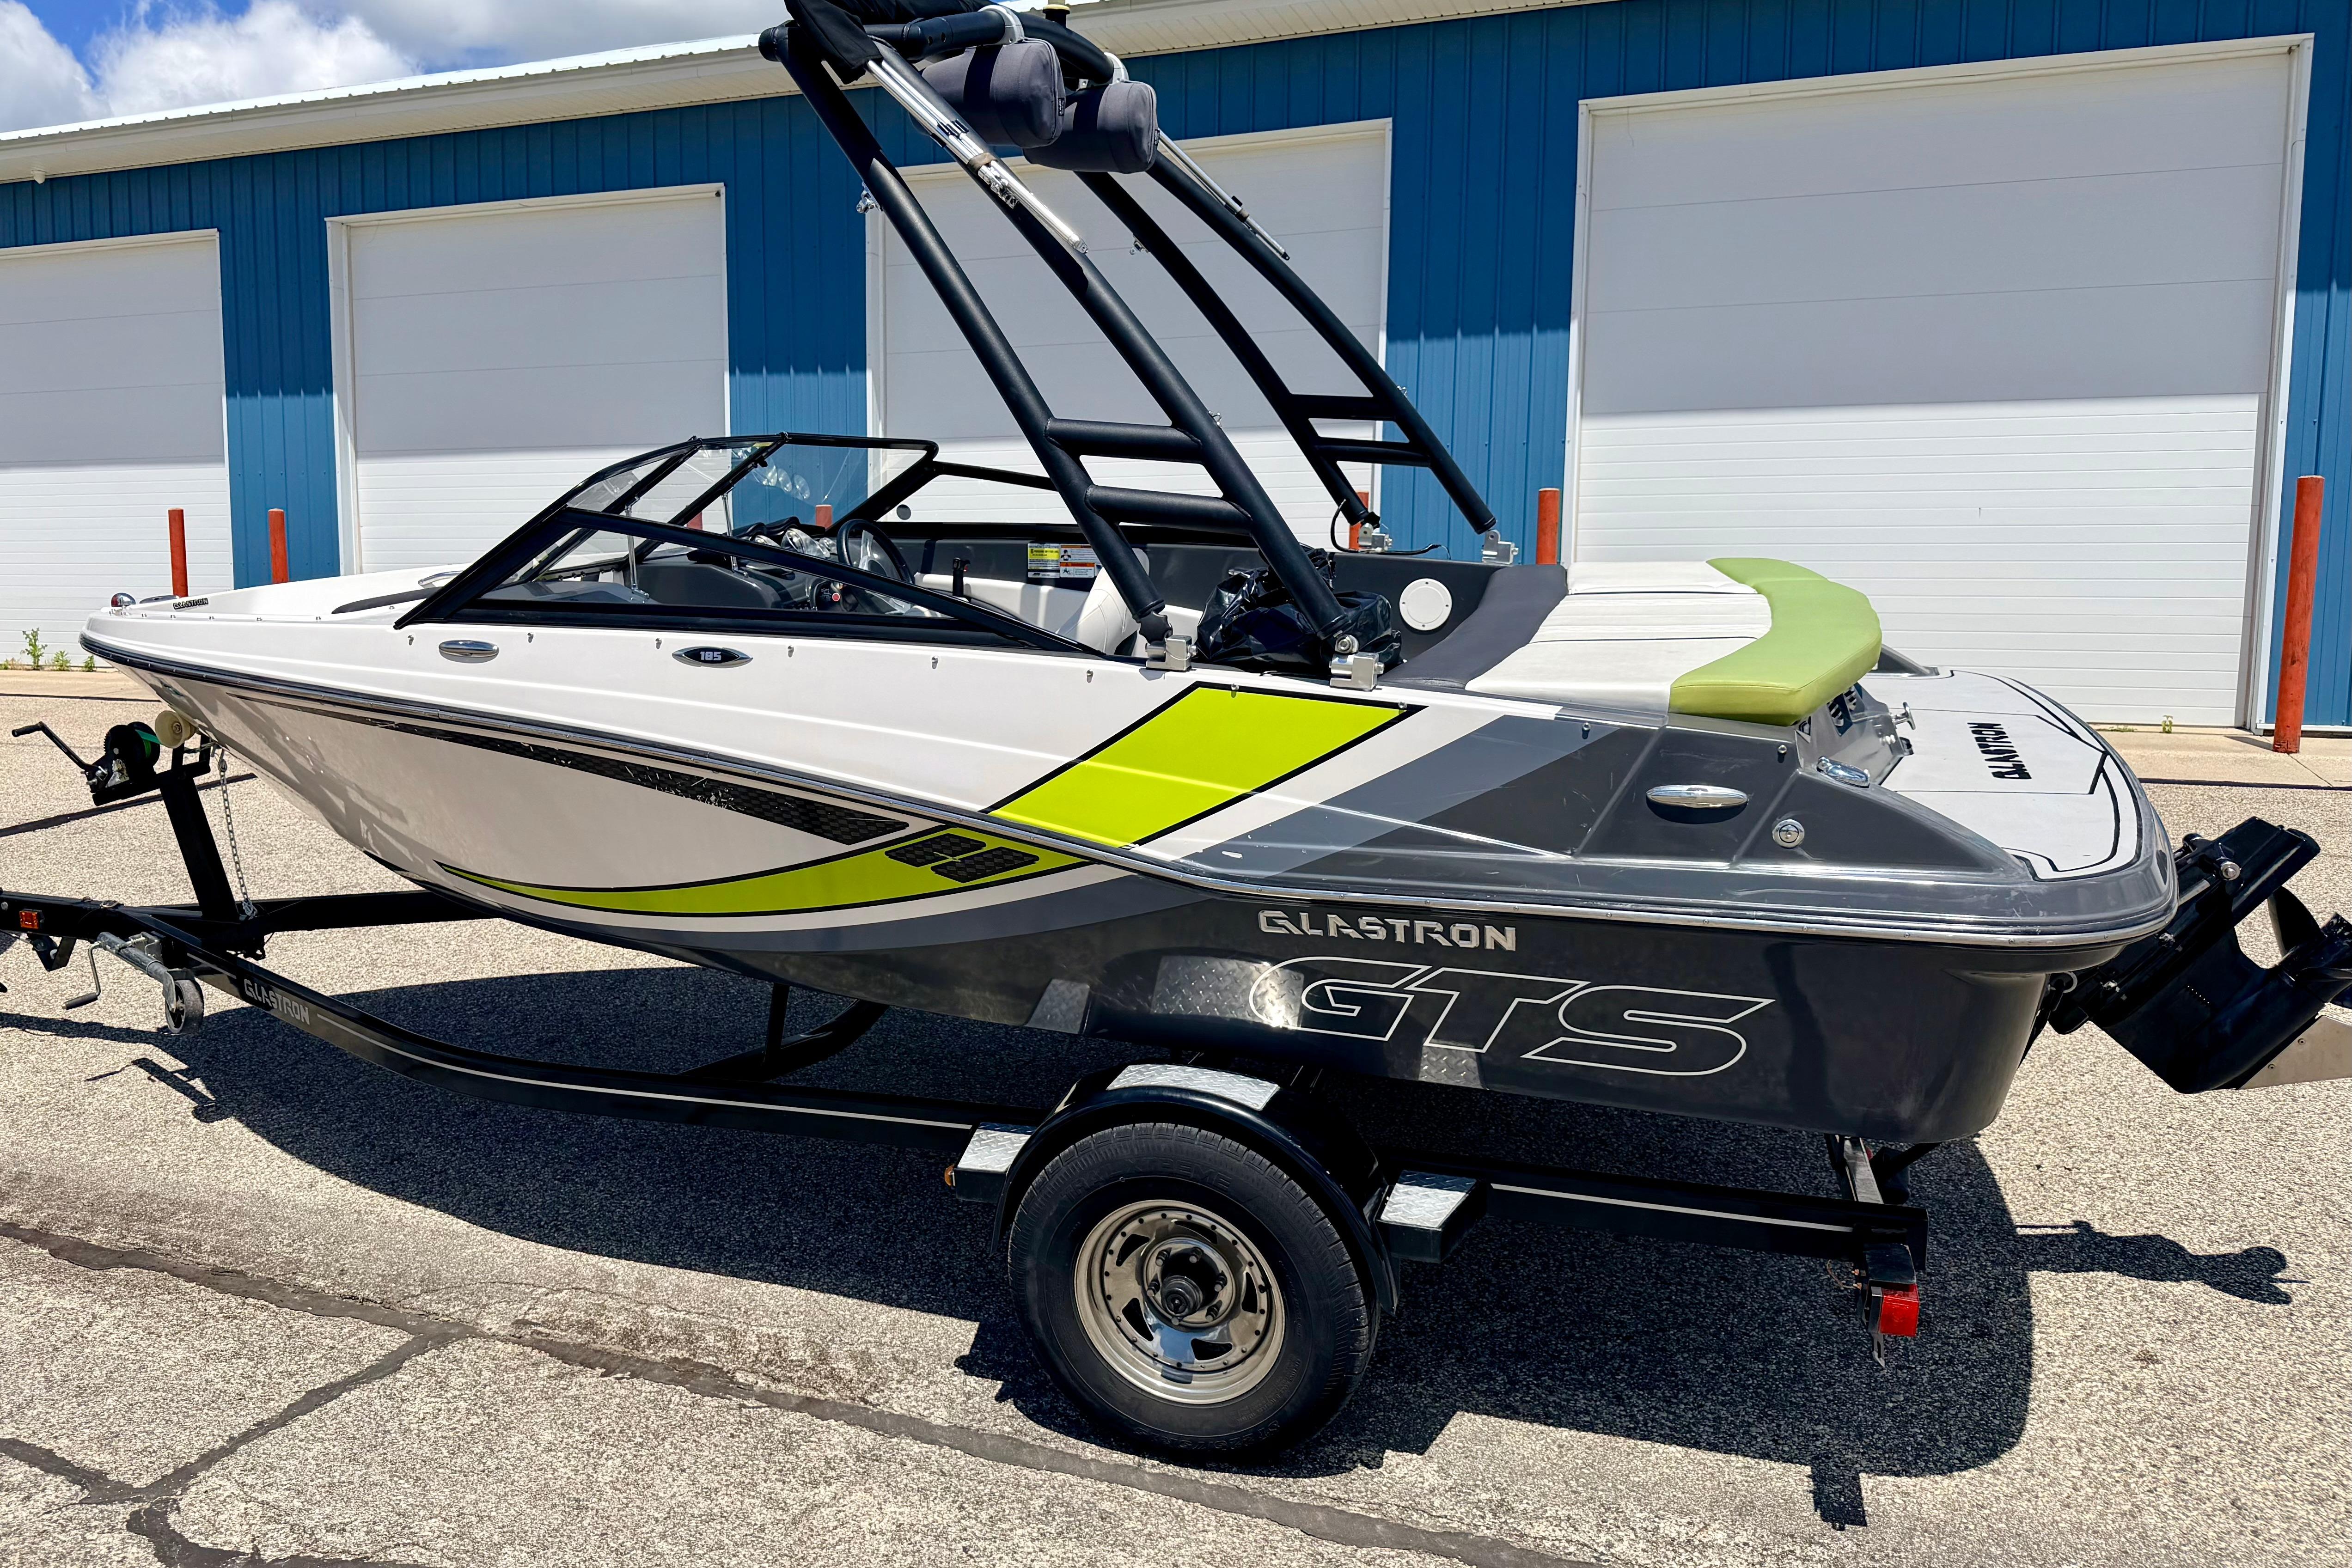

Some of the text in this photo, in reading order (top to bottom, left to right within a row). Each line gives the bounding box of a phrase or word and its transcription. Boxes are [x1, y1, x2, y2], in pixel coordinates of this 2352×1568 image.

[173, 598, 208, 610] GLASTRON
[700, 651, 721, 661] 185
[1967, 722, 2032, 780] GLASTRON
[1258, 910, 1516, 951] GLASTRON
[244, 979, 310, 1025] GLASTRON
[1250, 956, 1776, 1076] GTS
